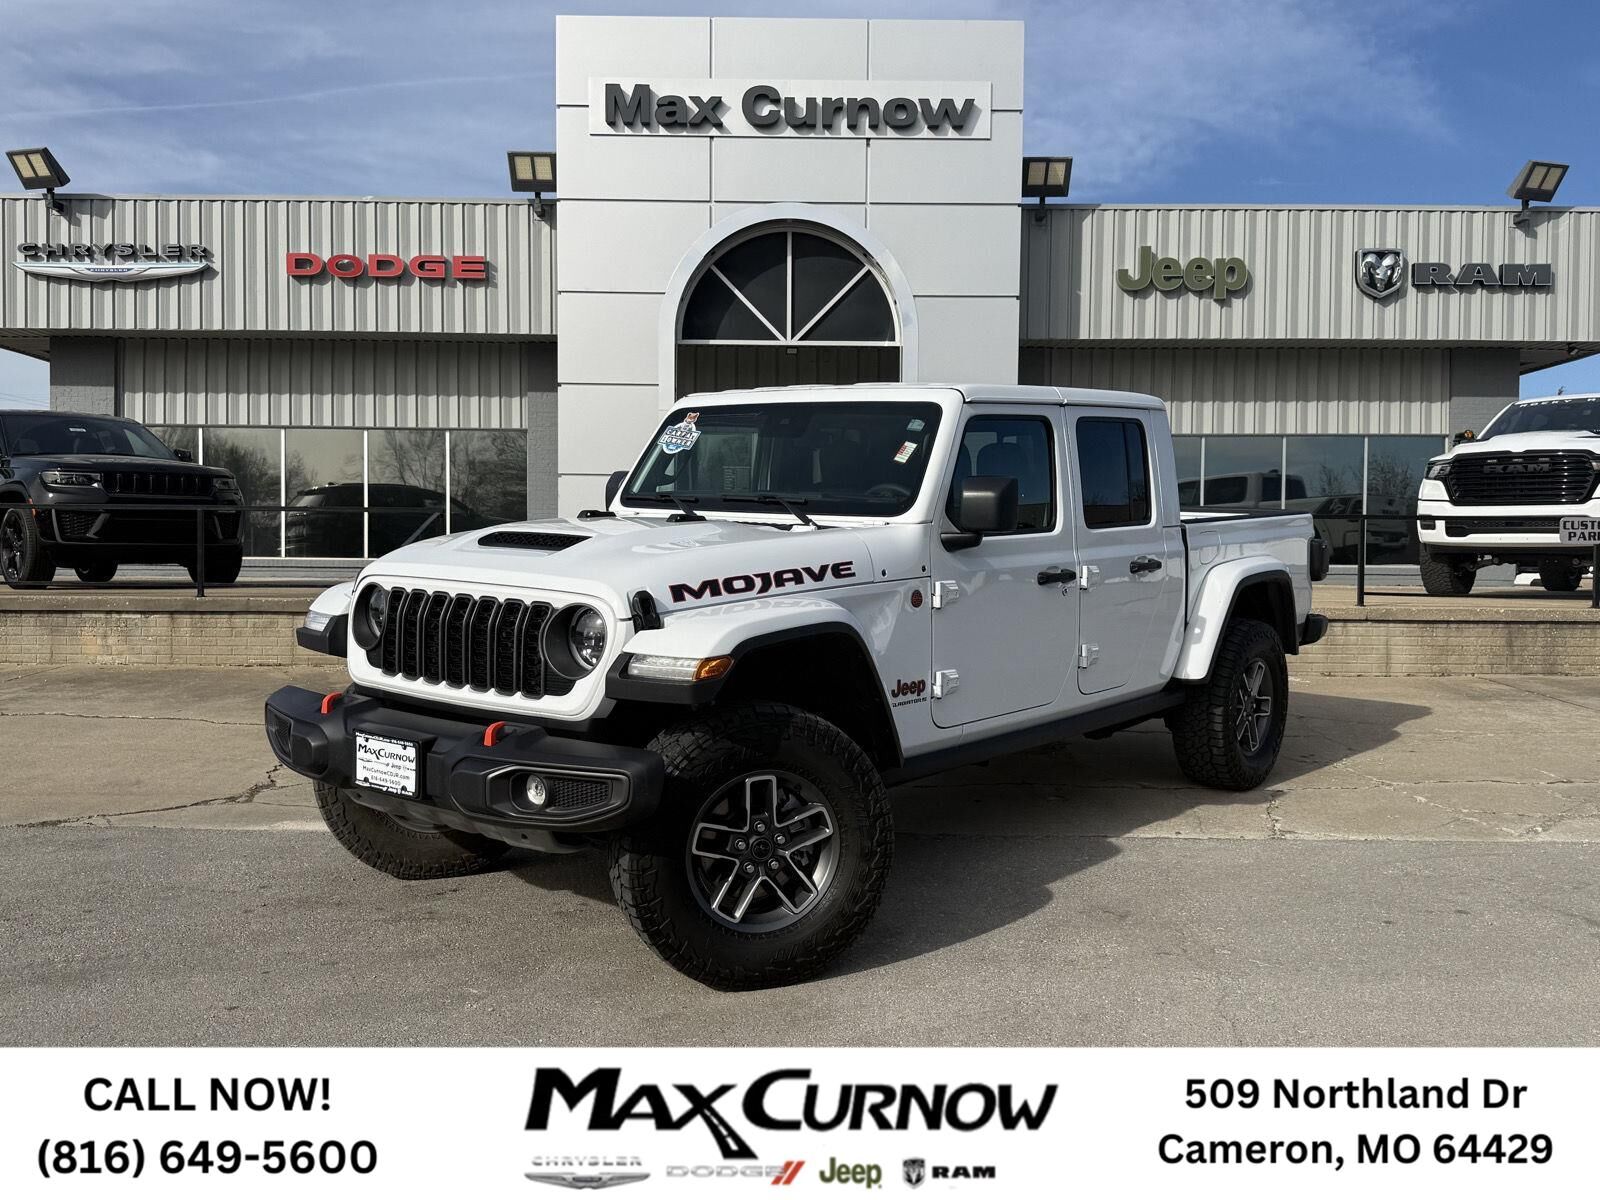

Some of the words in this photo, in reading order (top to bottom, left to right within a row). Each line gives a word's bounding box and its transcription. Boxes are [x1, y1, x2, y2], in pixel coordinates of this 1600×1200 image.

[605, 83, 723, 127] Max
[741, 85, 976, 129] Curnow
[17, 242, 206, 257] CHRYSLER
[286, 253, 486, 279] DODGE
[1116, 245, 1248, 300] Jeep
[1412, 262, 1553, 287] RAM
[1483, 463, 1551, 474] RAM
[1563, 520, 1600, 530] CUST
[1568, 531, 1600, 541] PAR
[669, 561, 856, 603] MOJAVE
[891, 679, 926, 698] Jeep
